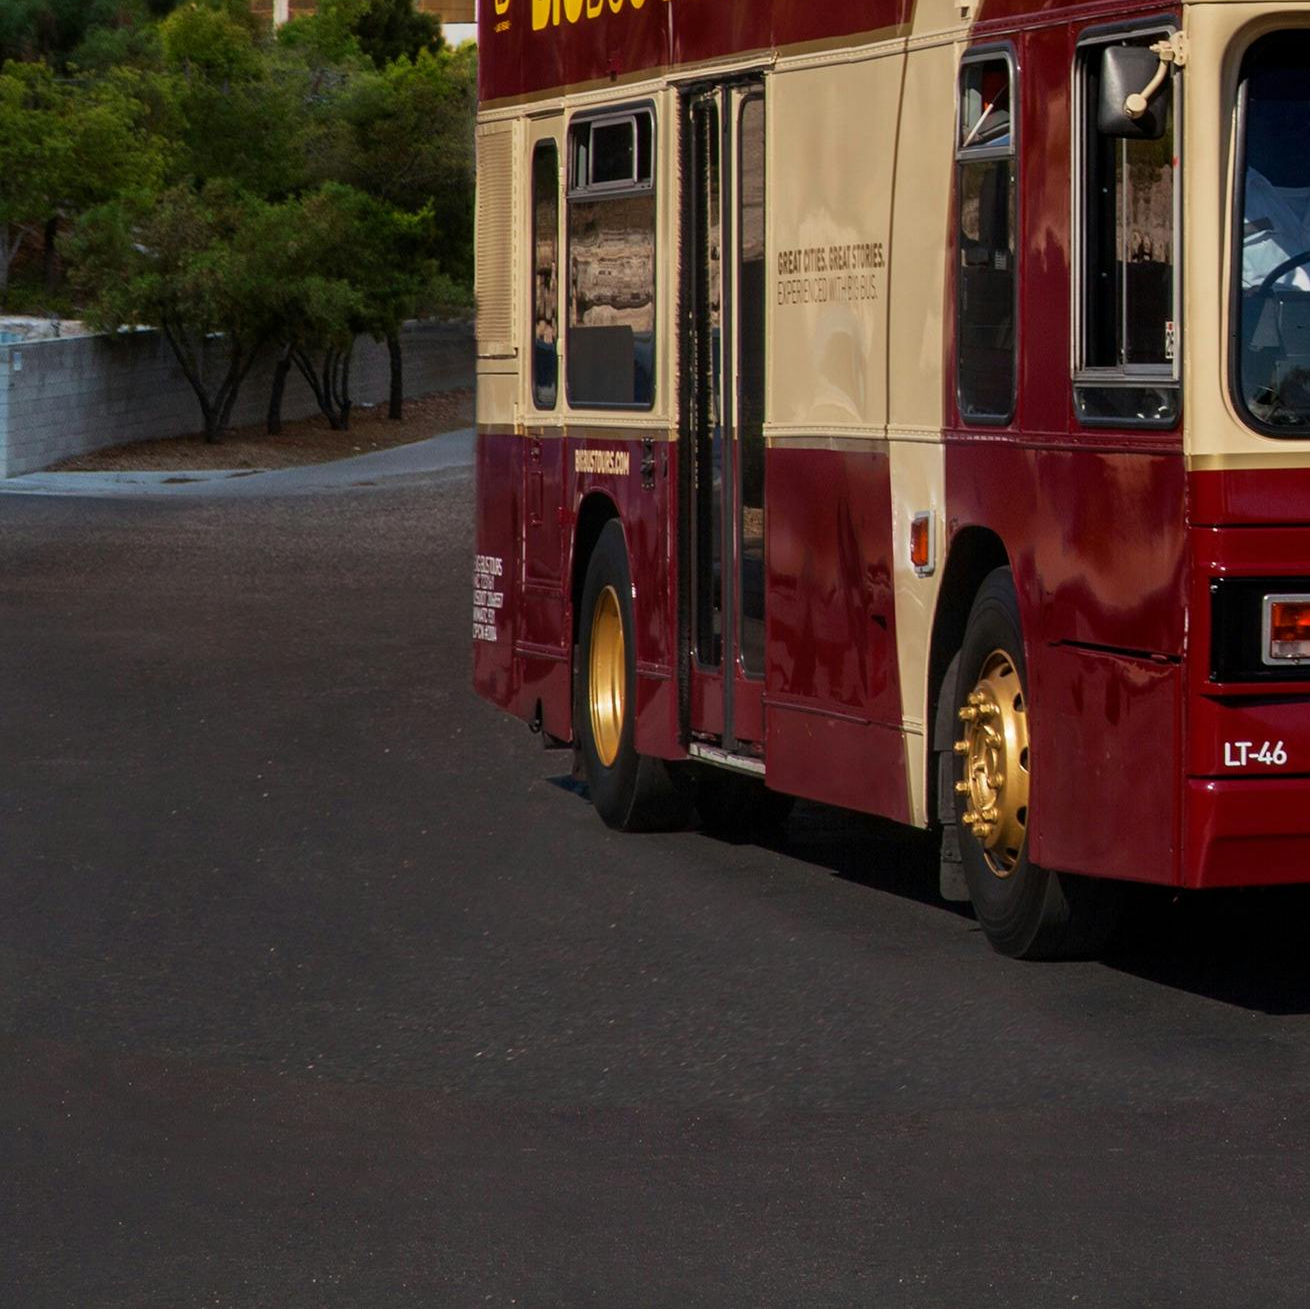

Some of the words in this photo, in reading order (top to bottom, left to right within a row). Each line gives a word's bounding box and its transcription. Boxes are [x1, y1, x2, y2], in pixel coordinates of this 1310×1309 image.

[778, 249, 802, 276] GREAT
[828, 245, 851, 271] GREAT
[1224, 740, 1288, 767] LT-46
